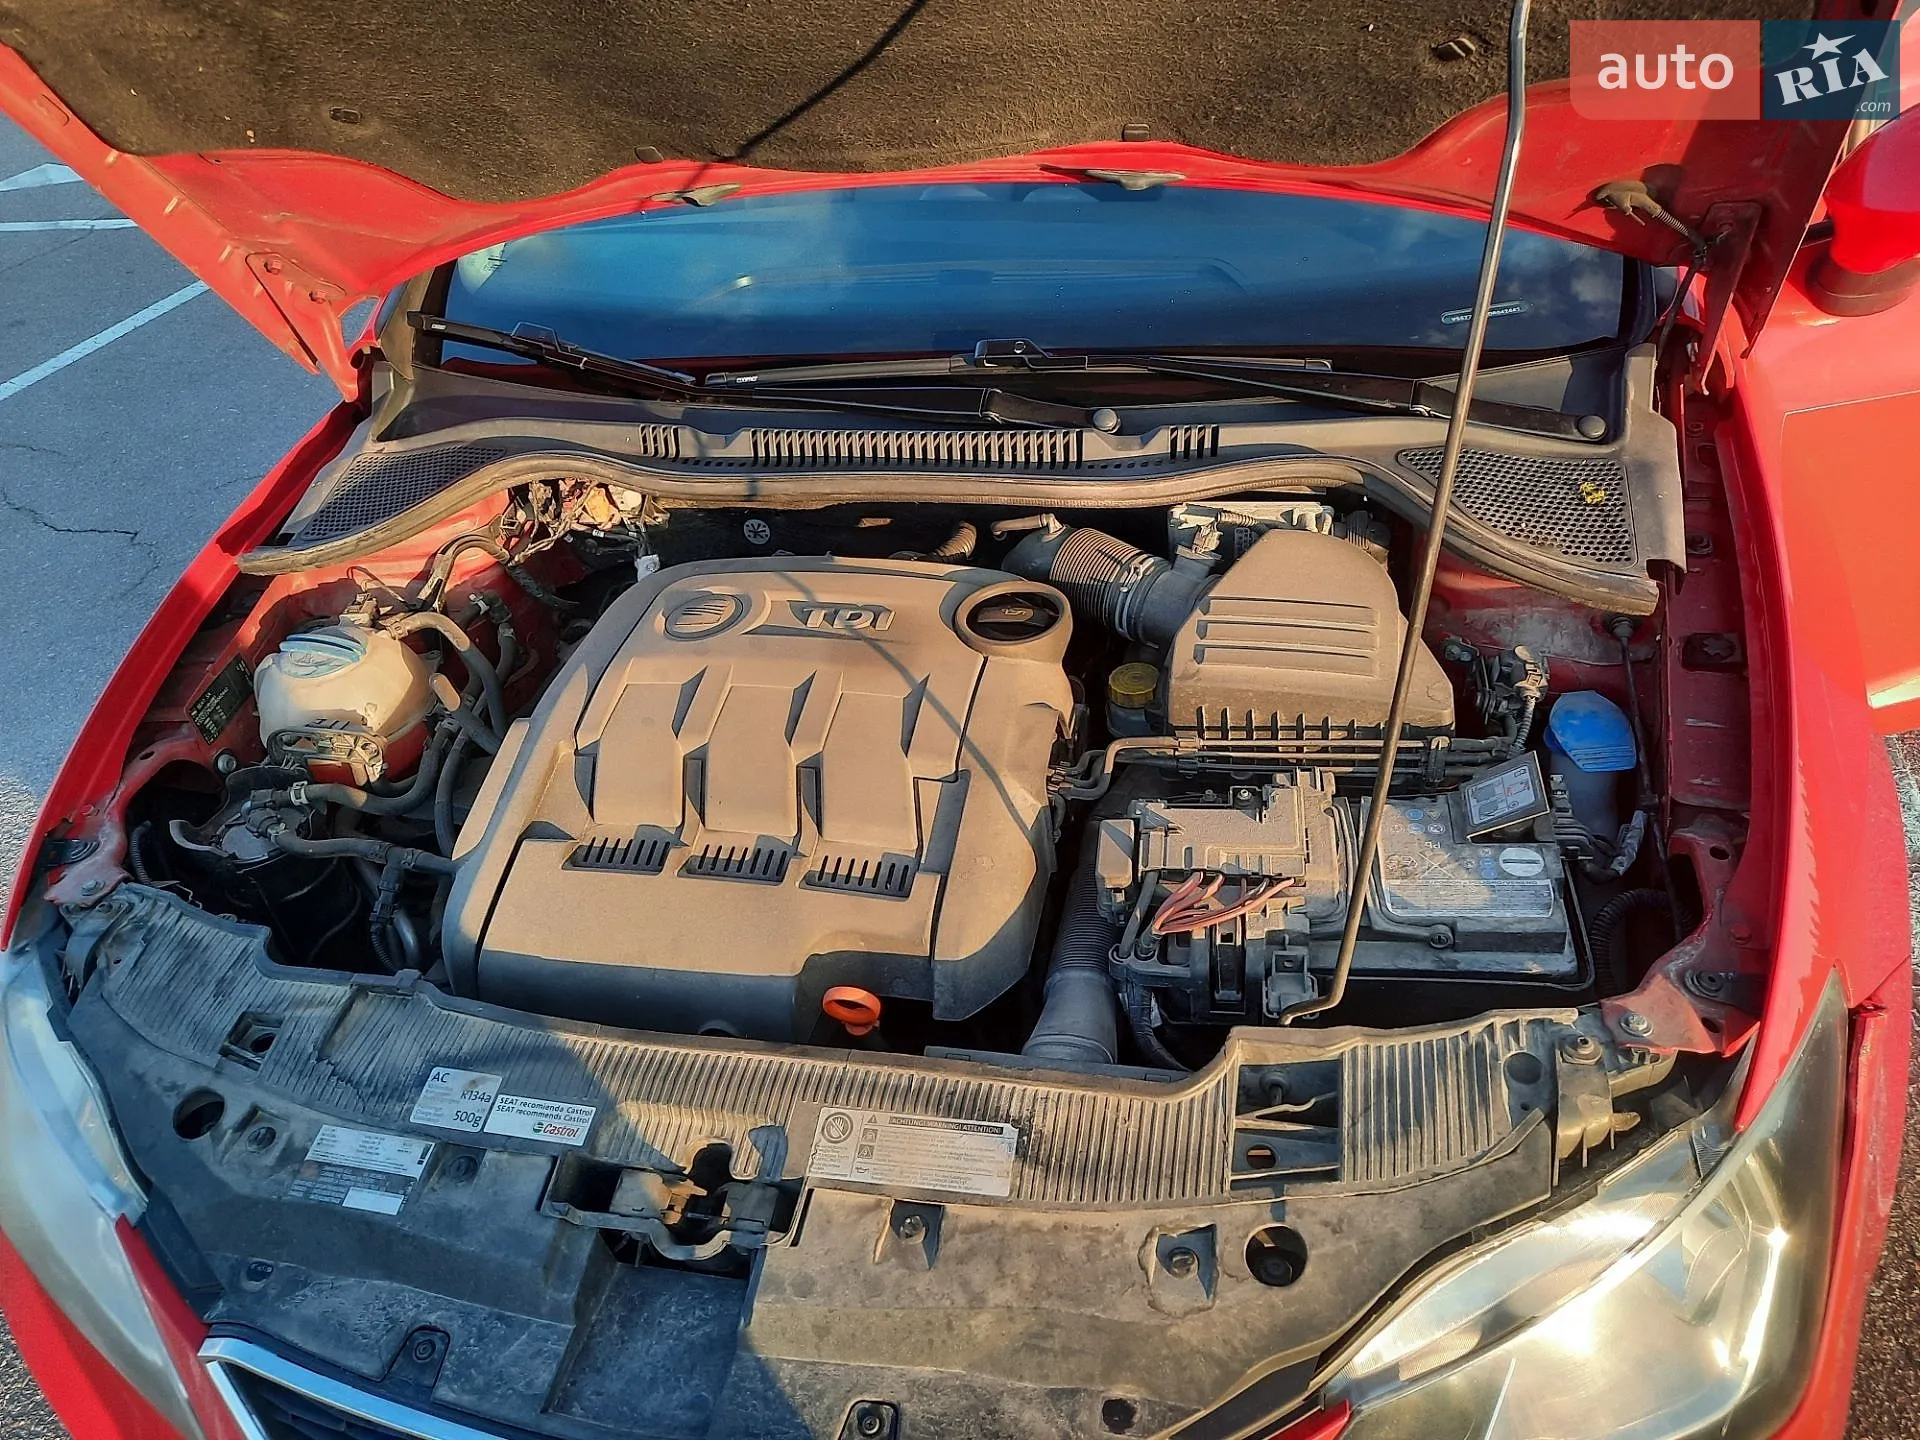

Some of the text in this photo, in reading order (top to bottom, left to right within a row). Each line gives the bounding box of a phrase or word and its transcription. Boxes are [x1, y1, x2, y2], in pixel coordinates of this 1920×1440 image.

[803, 607, 896, 632] TDI
[431, 1073, 450, 1083] AC
[496, 1104, 515, 1113] SEAT
[515, 1107, 562, 1120] recommends
[563, 1114, 591, 1124] Castrol
[499, 1096, 594, 1117] SEAT recomienda Castrol
[453, 1110, 482, 1128] 500g
[542, 1123, 580, 1138] Castrol
